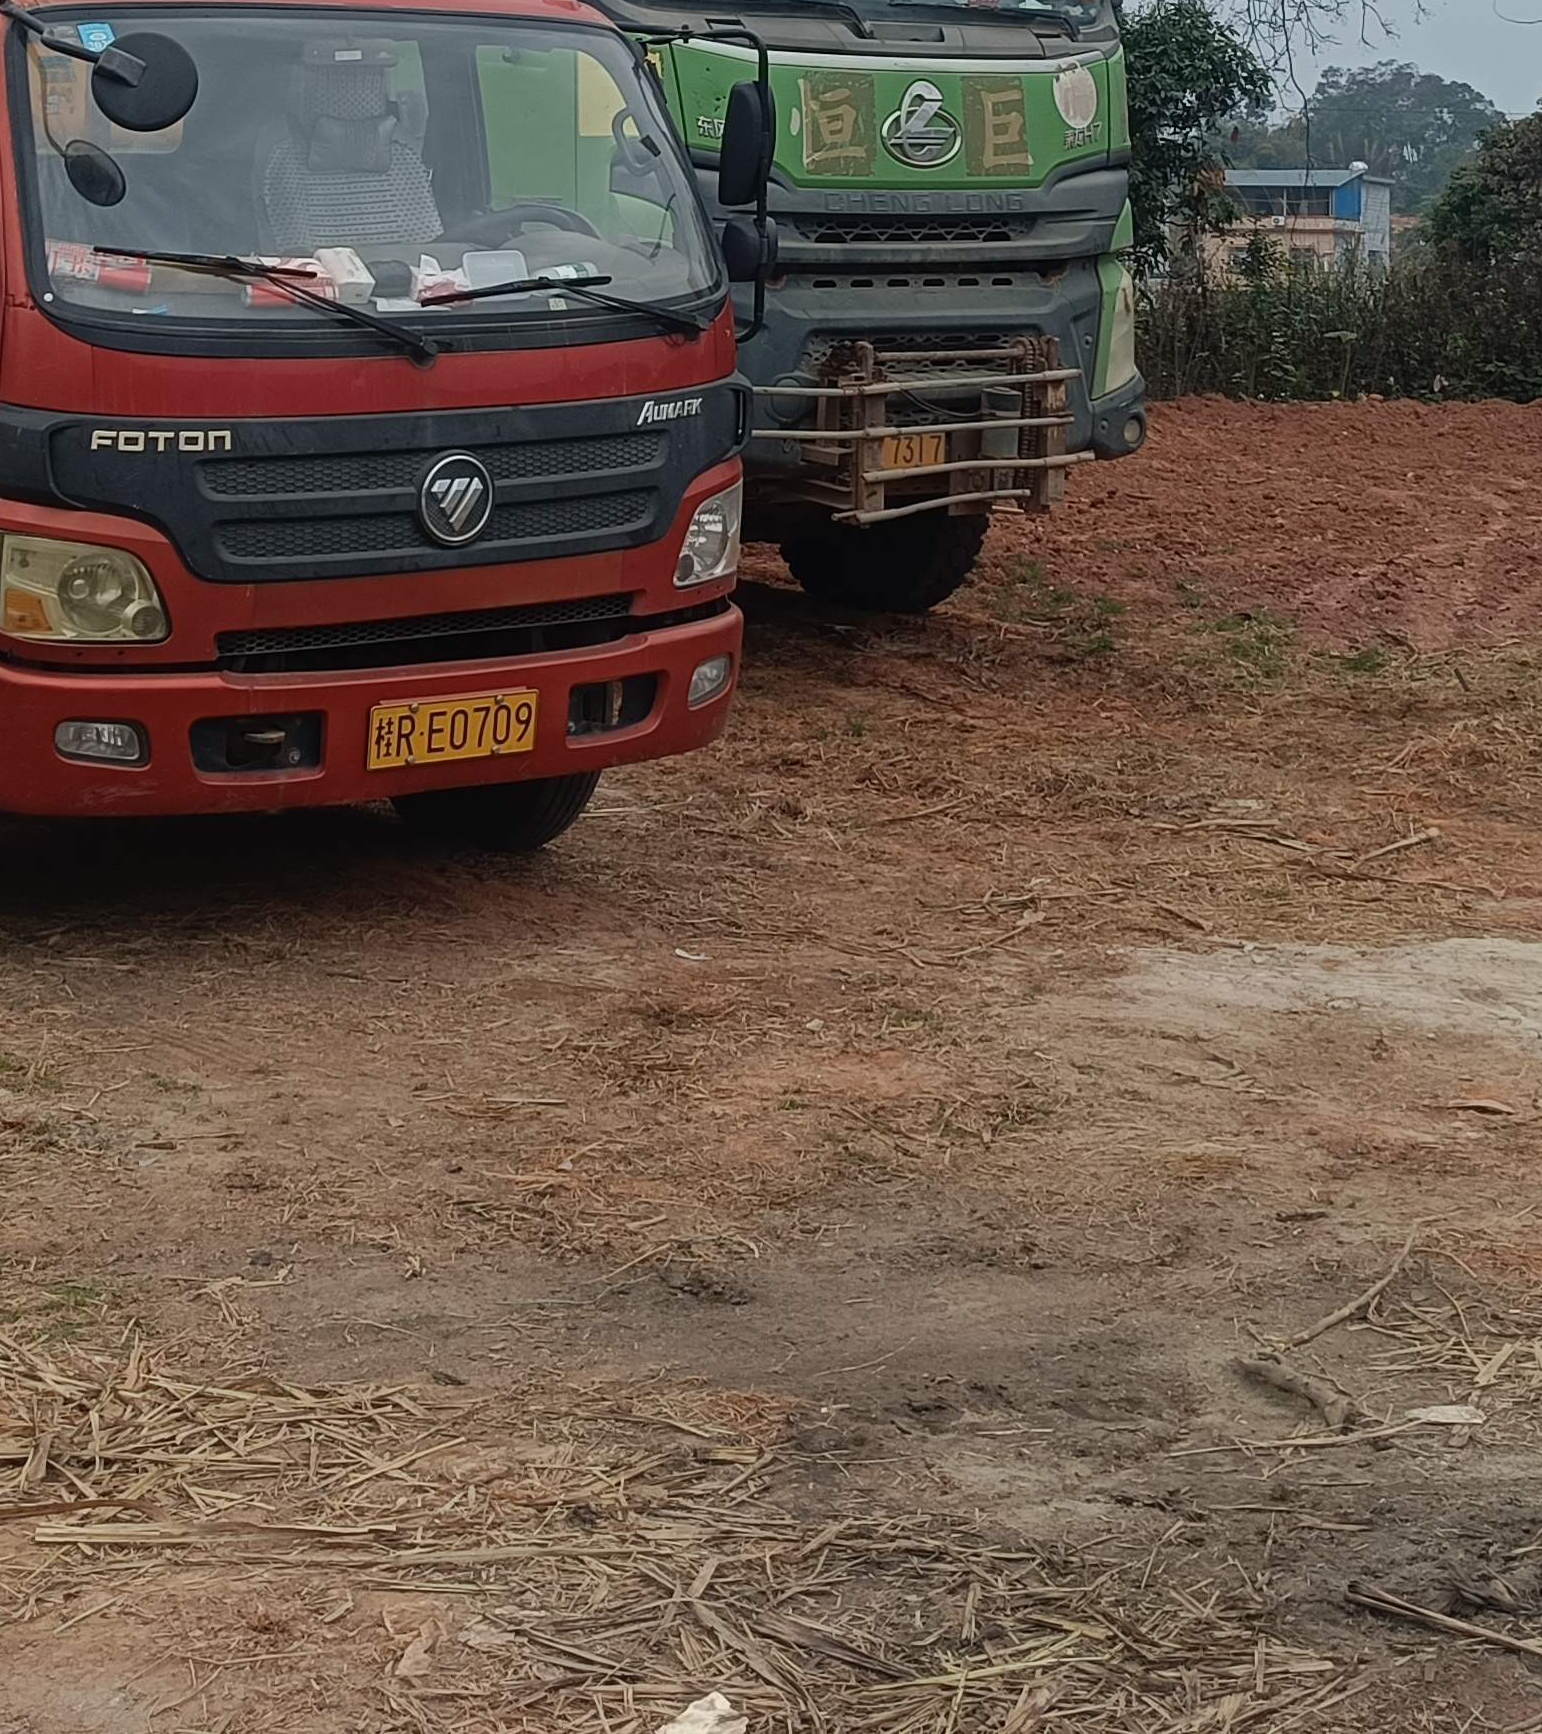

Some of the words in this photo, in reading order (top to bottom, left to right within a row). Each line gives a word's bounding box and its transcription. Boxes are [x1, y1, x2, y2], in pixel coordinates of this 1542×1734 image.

[824, 192, 932, 213] CHENG
[945, 192, 1024, 212] LONG
[90, 429, 232, 452] FOTON
[890, 434, 943, 465] 7317
